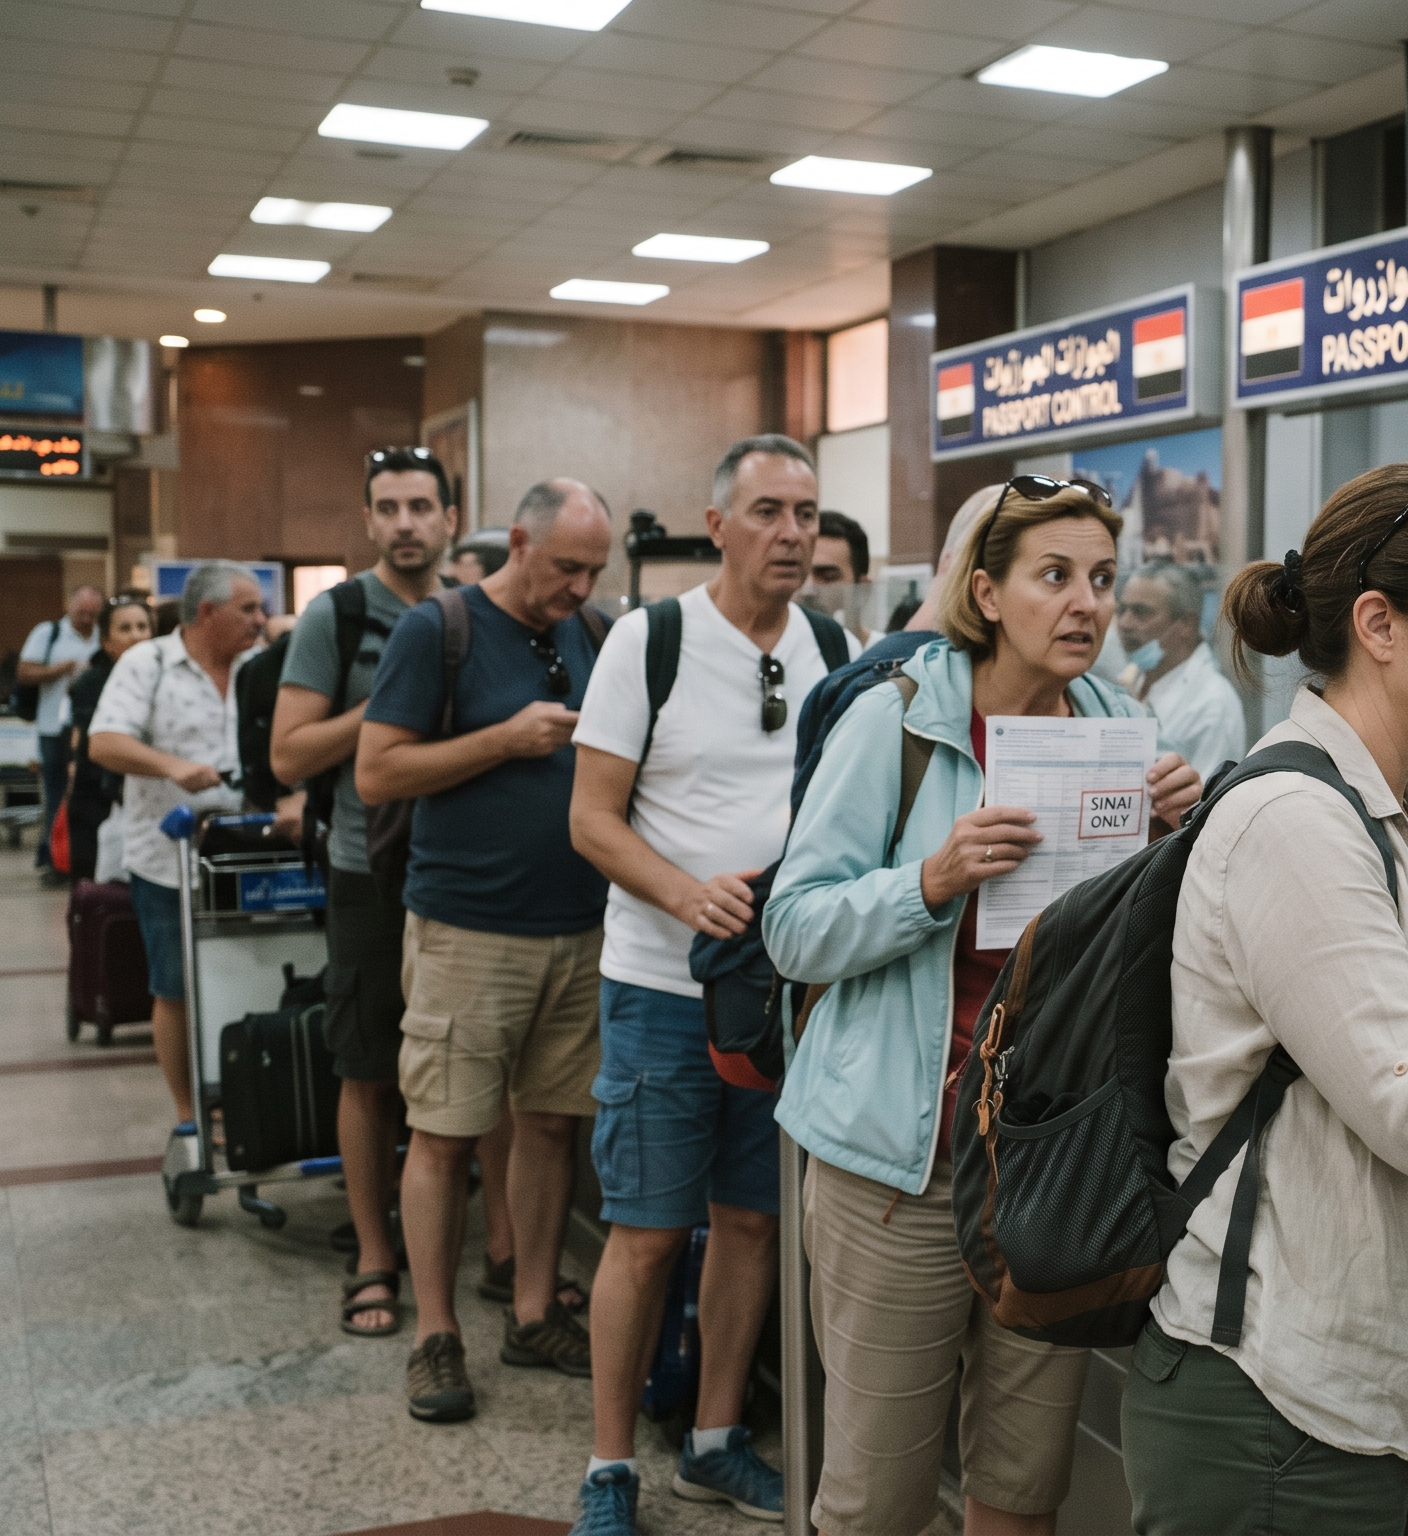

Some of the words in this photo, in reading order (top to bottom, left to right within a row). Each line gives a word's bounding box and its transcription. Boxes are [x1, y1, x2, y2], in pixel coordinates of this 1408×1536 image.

[982, 393, 1050, 438] PASSPORT
[1051, 380, 1123, 426] CONTROL
[1091, 796, 1132, 811] SINAI
[1091, 814, 1130, 828] ONLY
